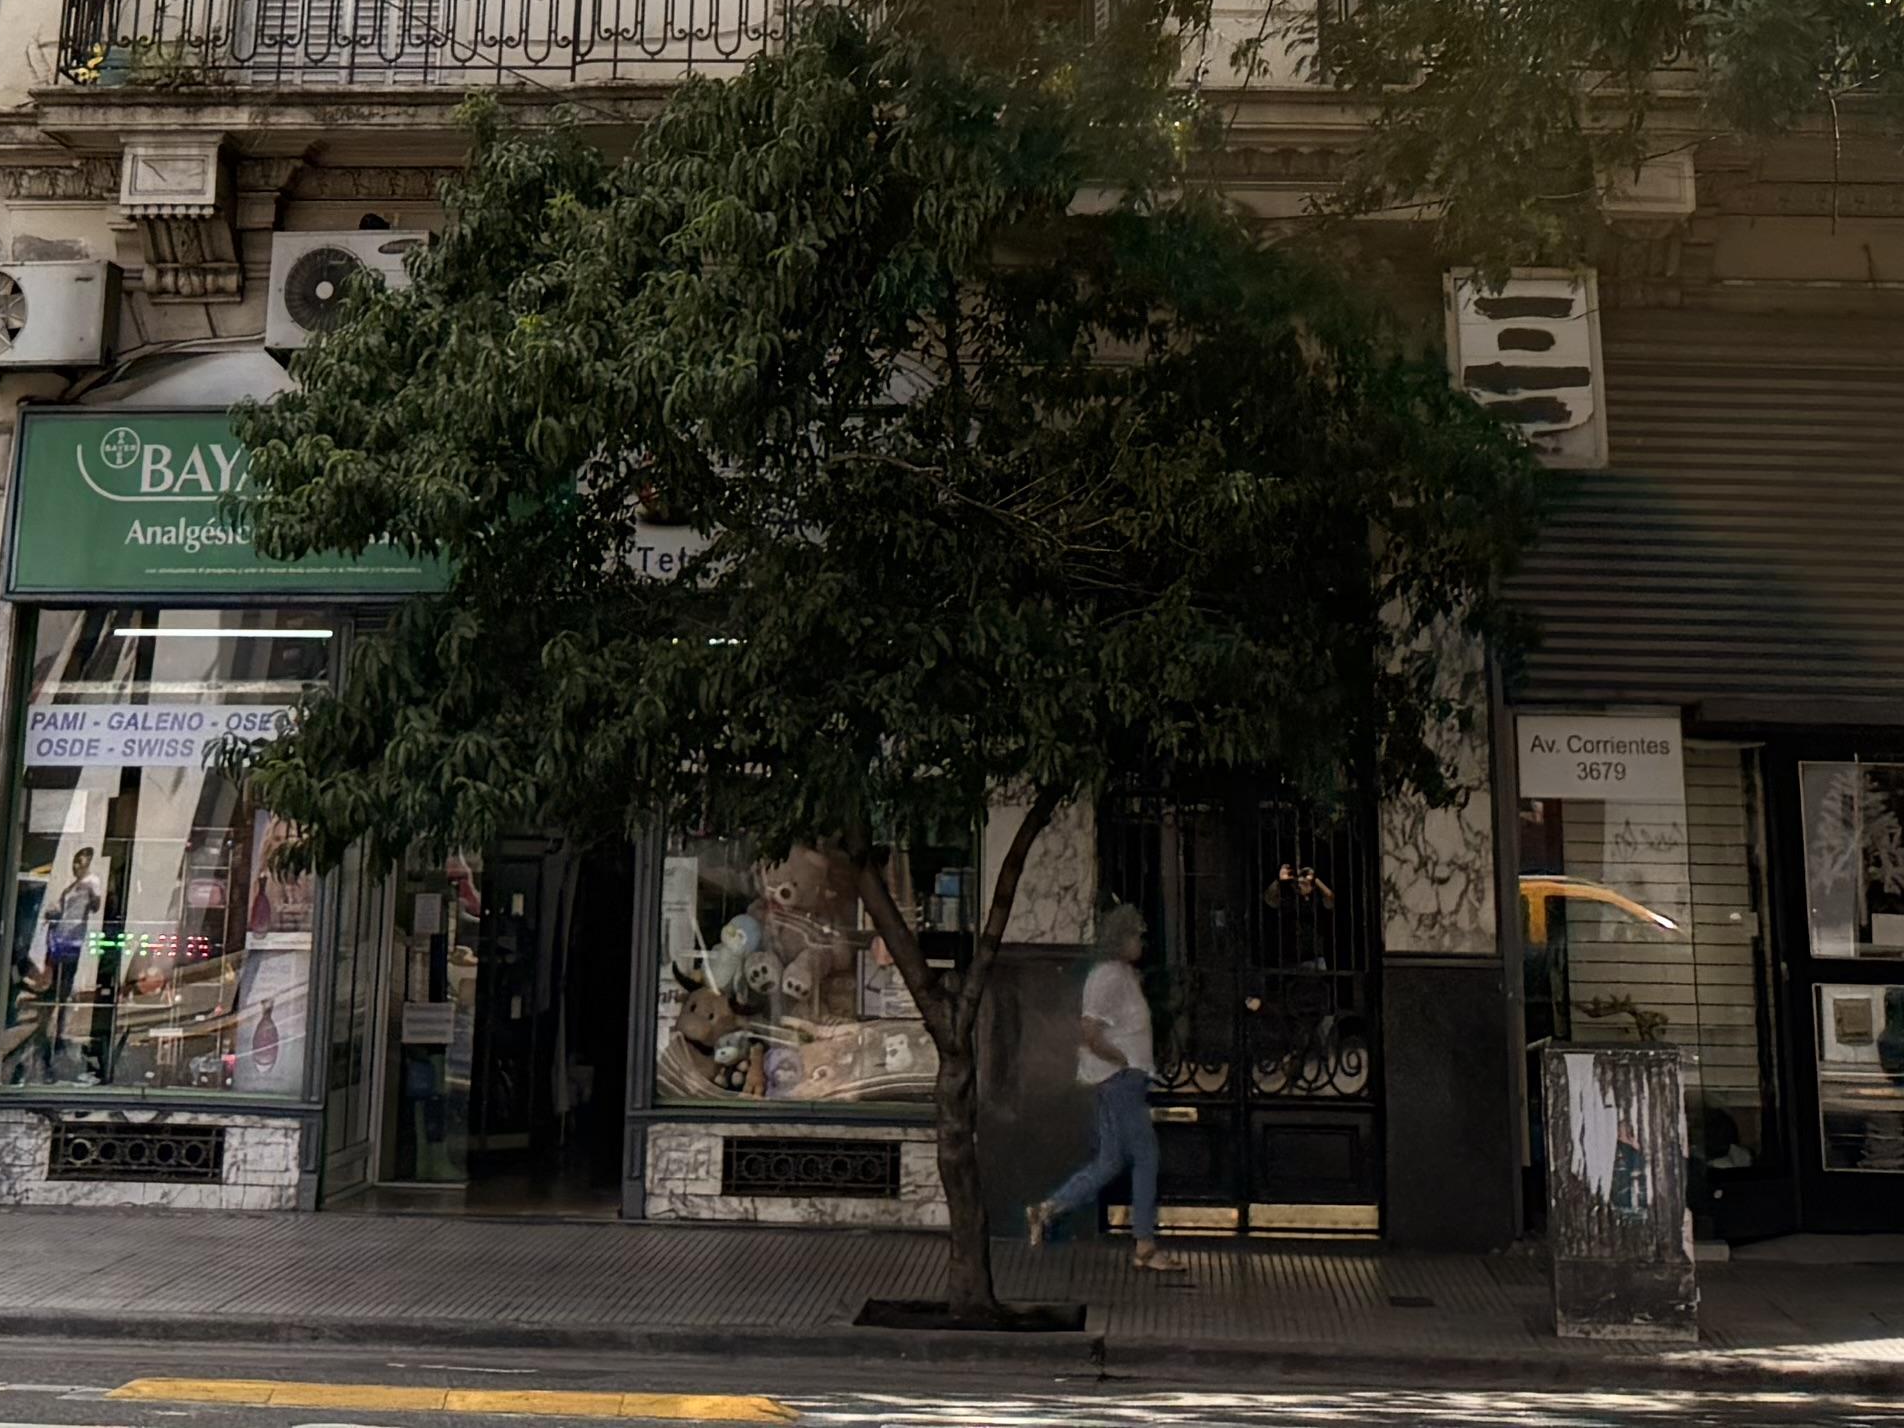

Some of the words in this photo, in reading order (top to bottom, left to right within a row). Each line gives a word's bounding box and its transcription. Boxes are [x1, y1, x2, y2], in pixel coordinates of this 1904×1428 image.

[124, 517, 255, 554] Analgésic
[30, 712, 86, 731] PAMI
[107, 712, 204, 731] GALENO
[226, 712, 273, 731] OSE
[36, 738, 100, 757] OSDE
[122, 738, 195, 757] SWISS
[1530, 735, 1561, 753] Av.
[1567, 735, 1671, 755] Corrientes
[1576, 762, 1627, 781] 3679
